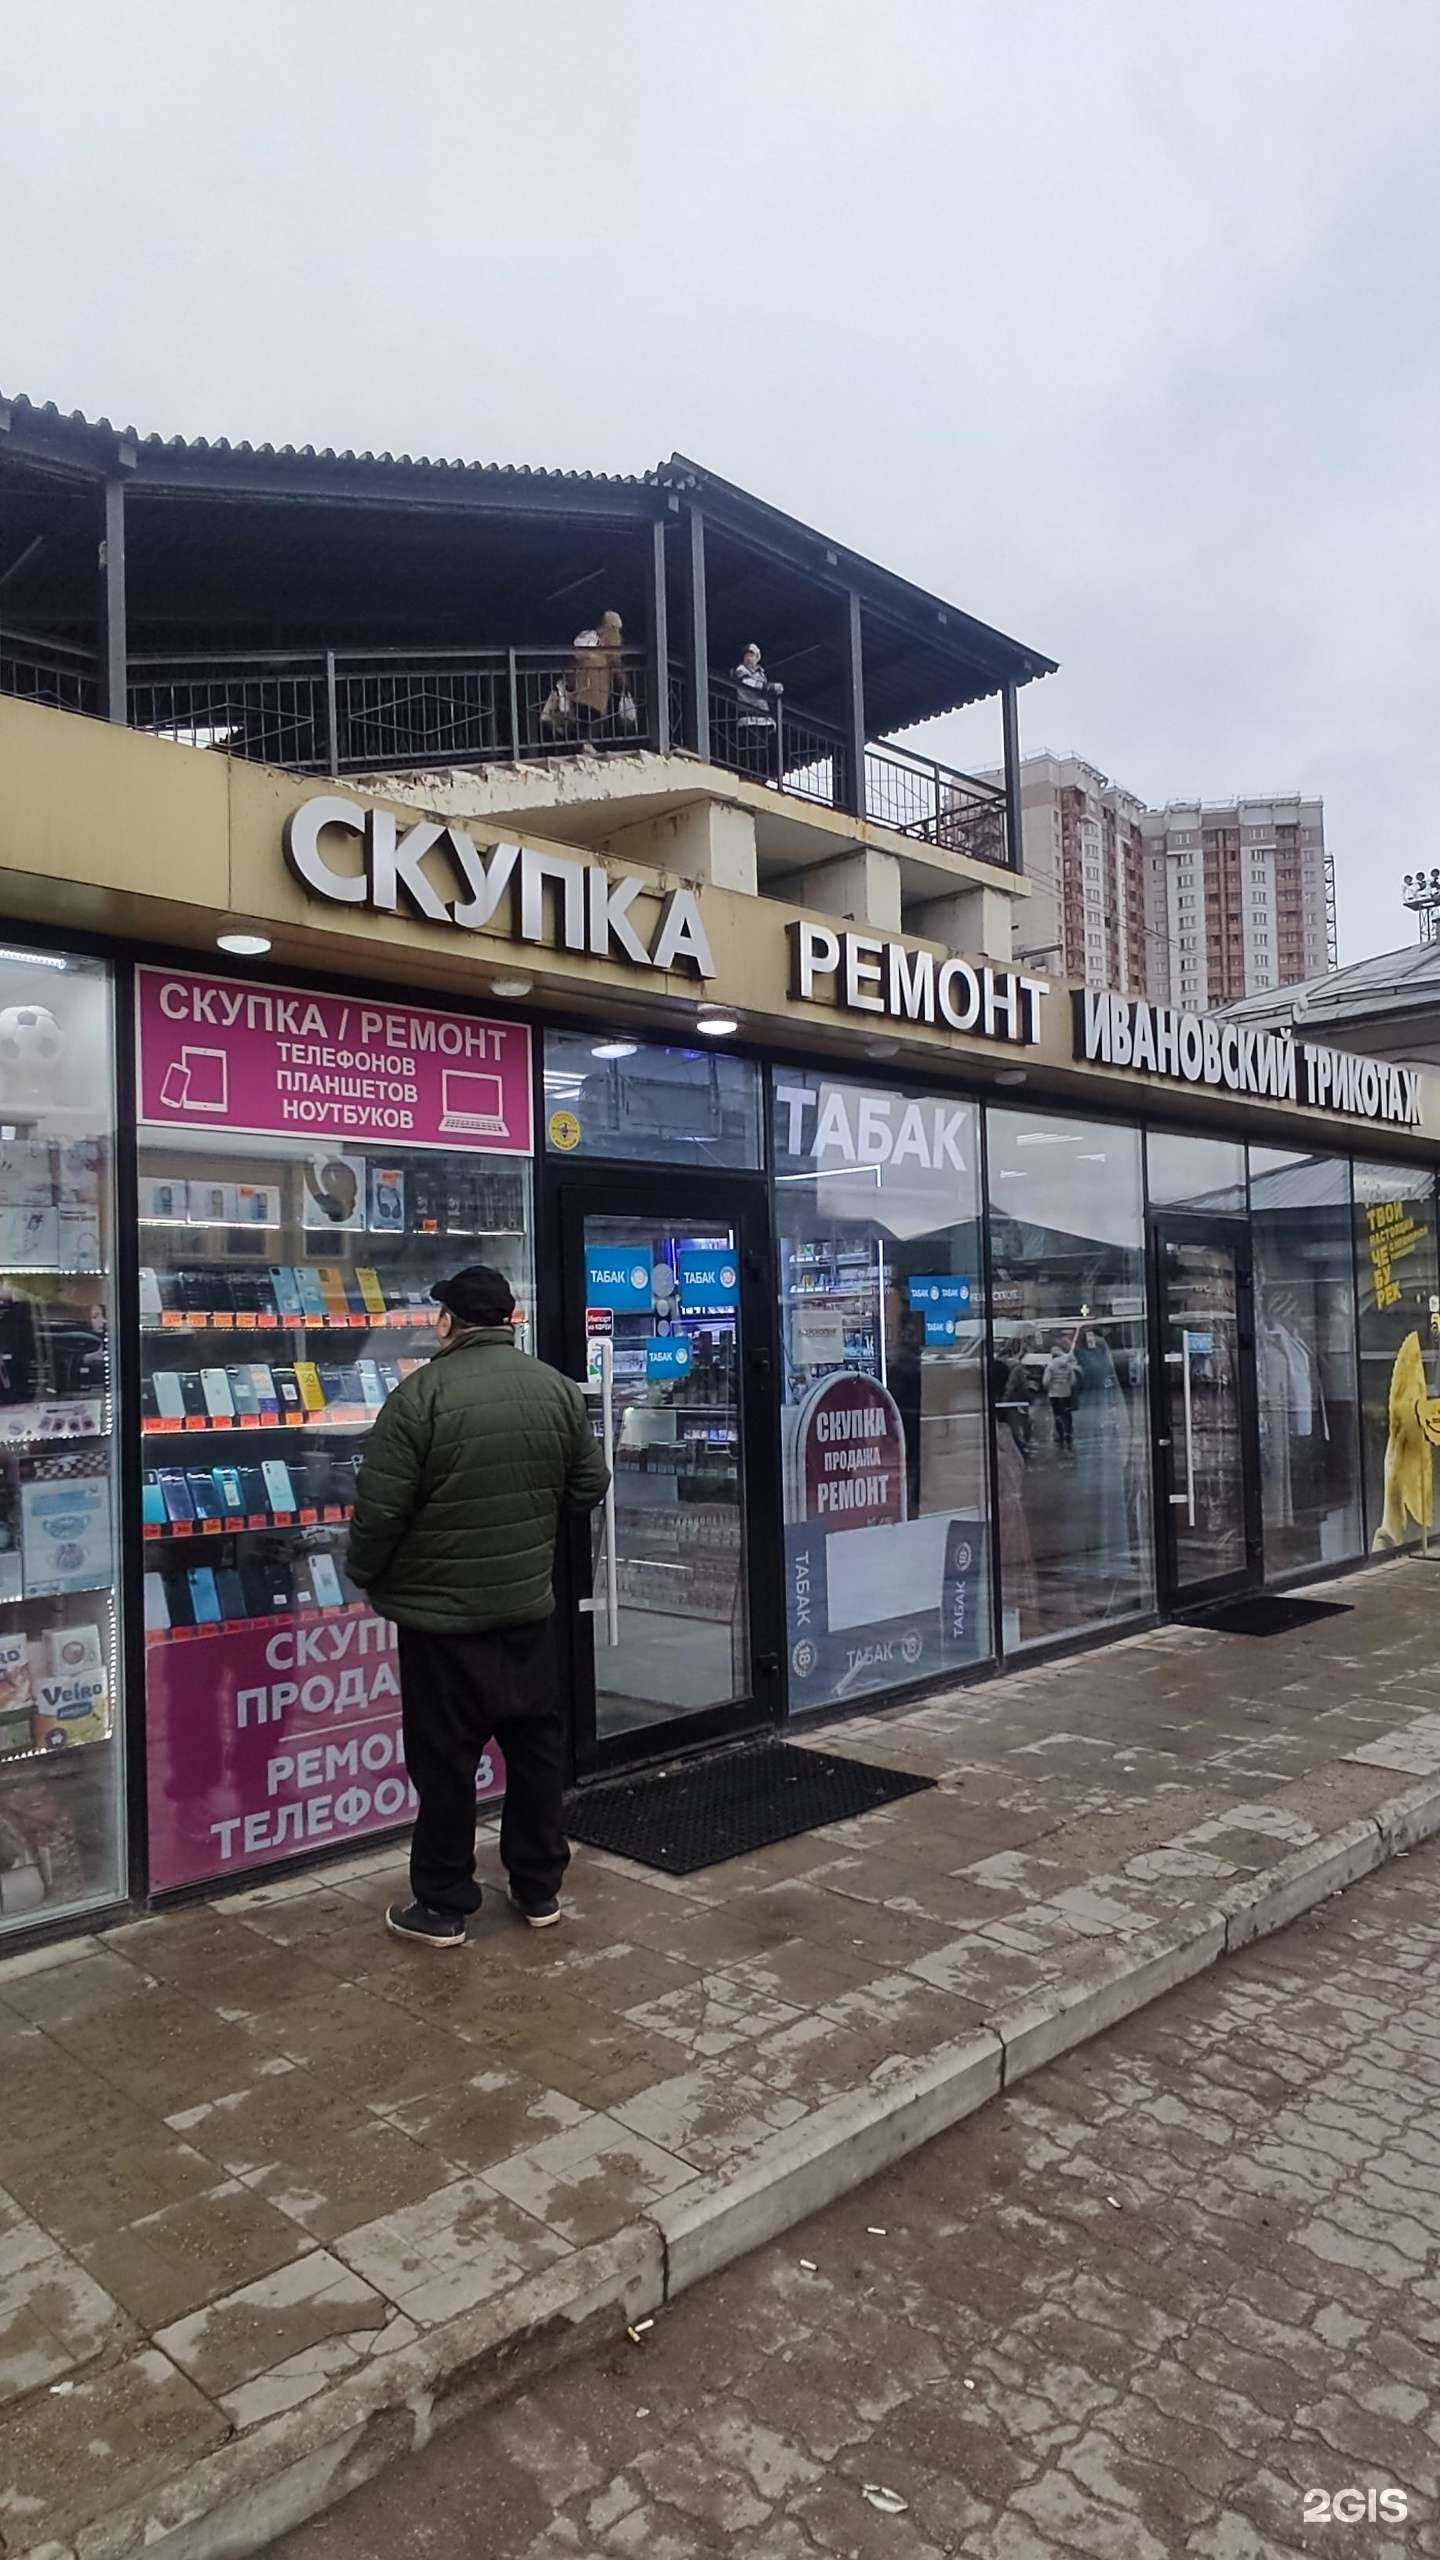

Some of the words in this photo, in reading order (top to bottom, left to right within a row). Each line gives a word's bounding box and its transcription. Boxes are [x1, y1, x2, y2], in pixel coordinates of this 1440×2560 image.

[285, 796, 716, 978] СКУПКА
[798, 920, 1050, 1045] РЕМОНТ
[160, 983, 328, 1039] СКУПКА
[361, 1011, 507, 1061] РЕМОНТ
[277, 1042, 416, 1077] ТЕЛЕФОНОВ
[1084, 987, 1297, 1100] ИВАНОВСКИЙ
[1304, 1044, 1424, 1125] ТРИКОТАЖ
[276, 1070, 418, 1103] ПЛАНШЕТОВ
[283, 1099, 414, 1129] НОУТБУКОВ
[776, 1085, 967, 1171] ТАБАК
[590, 1270, 625, 1283] ТАБАК
[684, 1271, 715, 1284] ТАБАК
[649, 1352, 673, 1361] ТАБАК
[816, 1407, 887, 1442] СКУПКА
[824, 1446, 881, 1472] ПРОДАЖА
[817, 1475, 889, 1513] РЕМОНТ
[795, 1550, 811, 1627] ТАБАК
[953, 1581, 966, 1639] ТАБАК
[266, 1617, 398, 1670] СКУП
[846, 1641, 894, 1669] ТАБАК
[237, 1663, 401, 1728] ПРОДА
[268, 1729, 405, 1795] РЕМО
